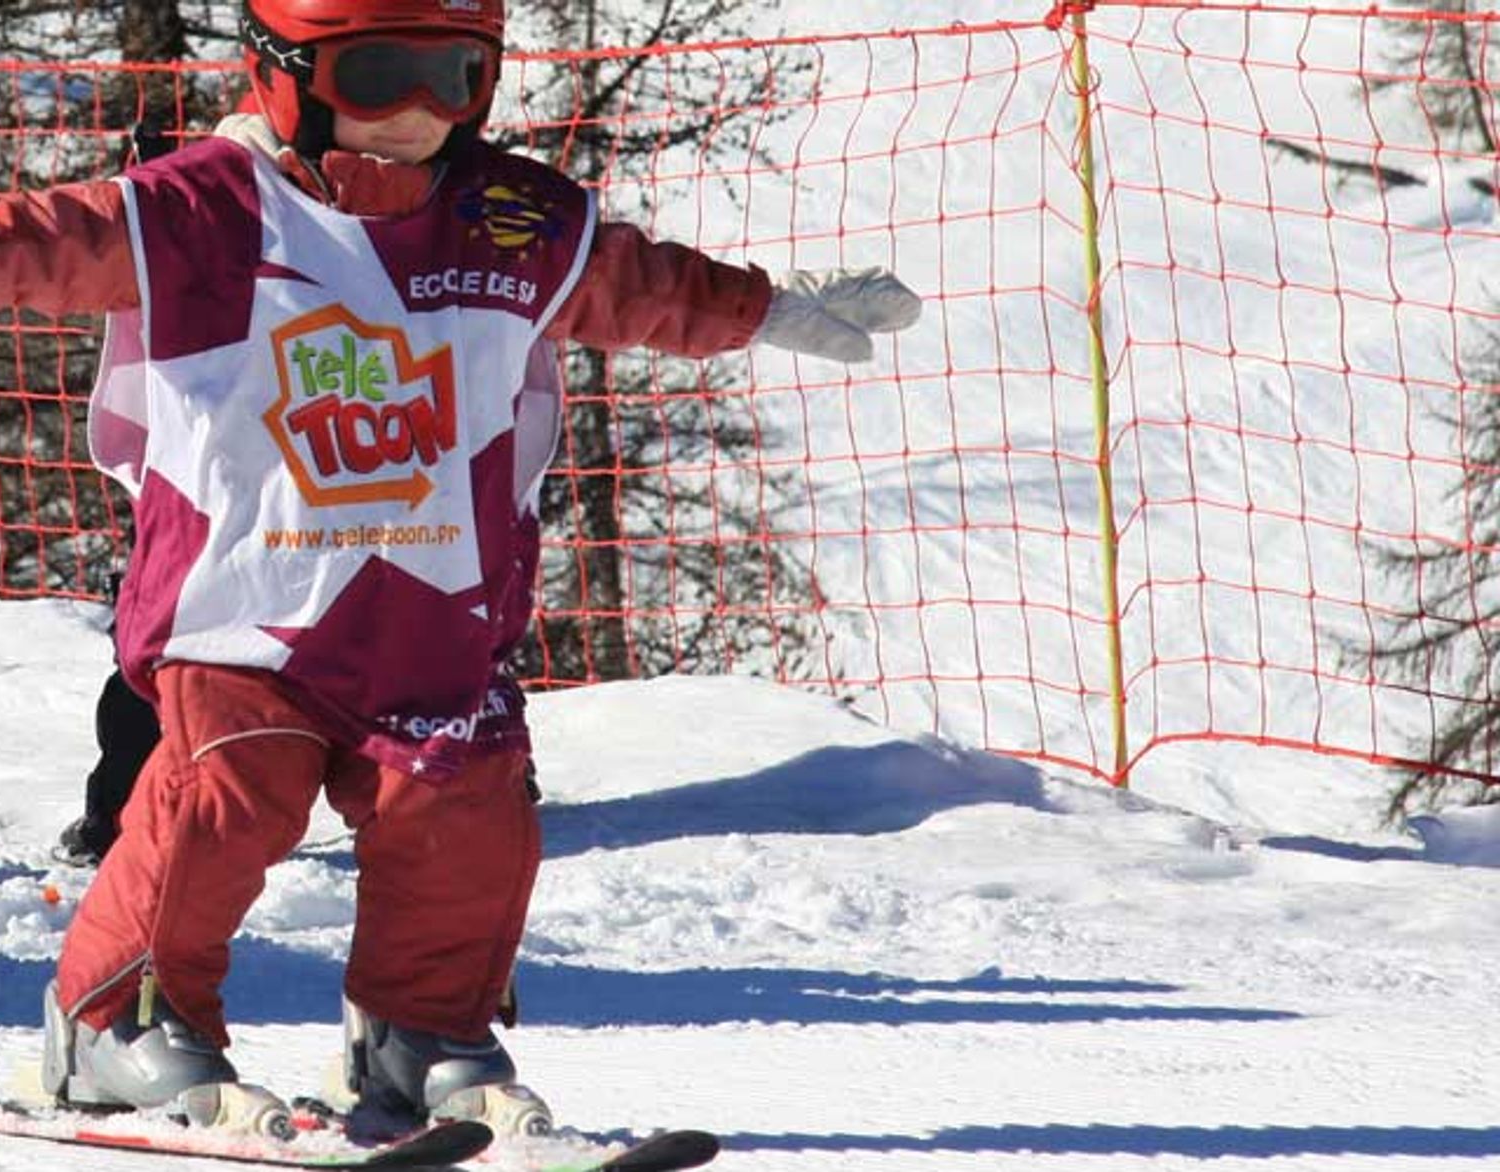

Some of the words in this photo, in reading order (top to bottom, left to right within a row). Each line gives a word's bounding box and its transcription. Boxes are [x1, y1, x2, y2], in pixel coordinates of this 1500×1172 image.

[409, 268, 483, 298] ECOE
[487, 271, 516, 299] DE
[286, 365, 457, 478] TOON
